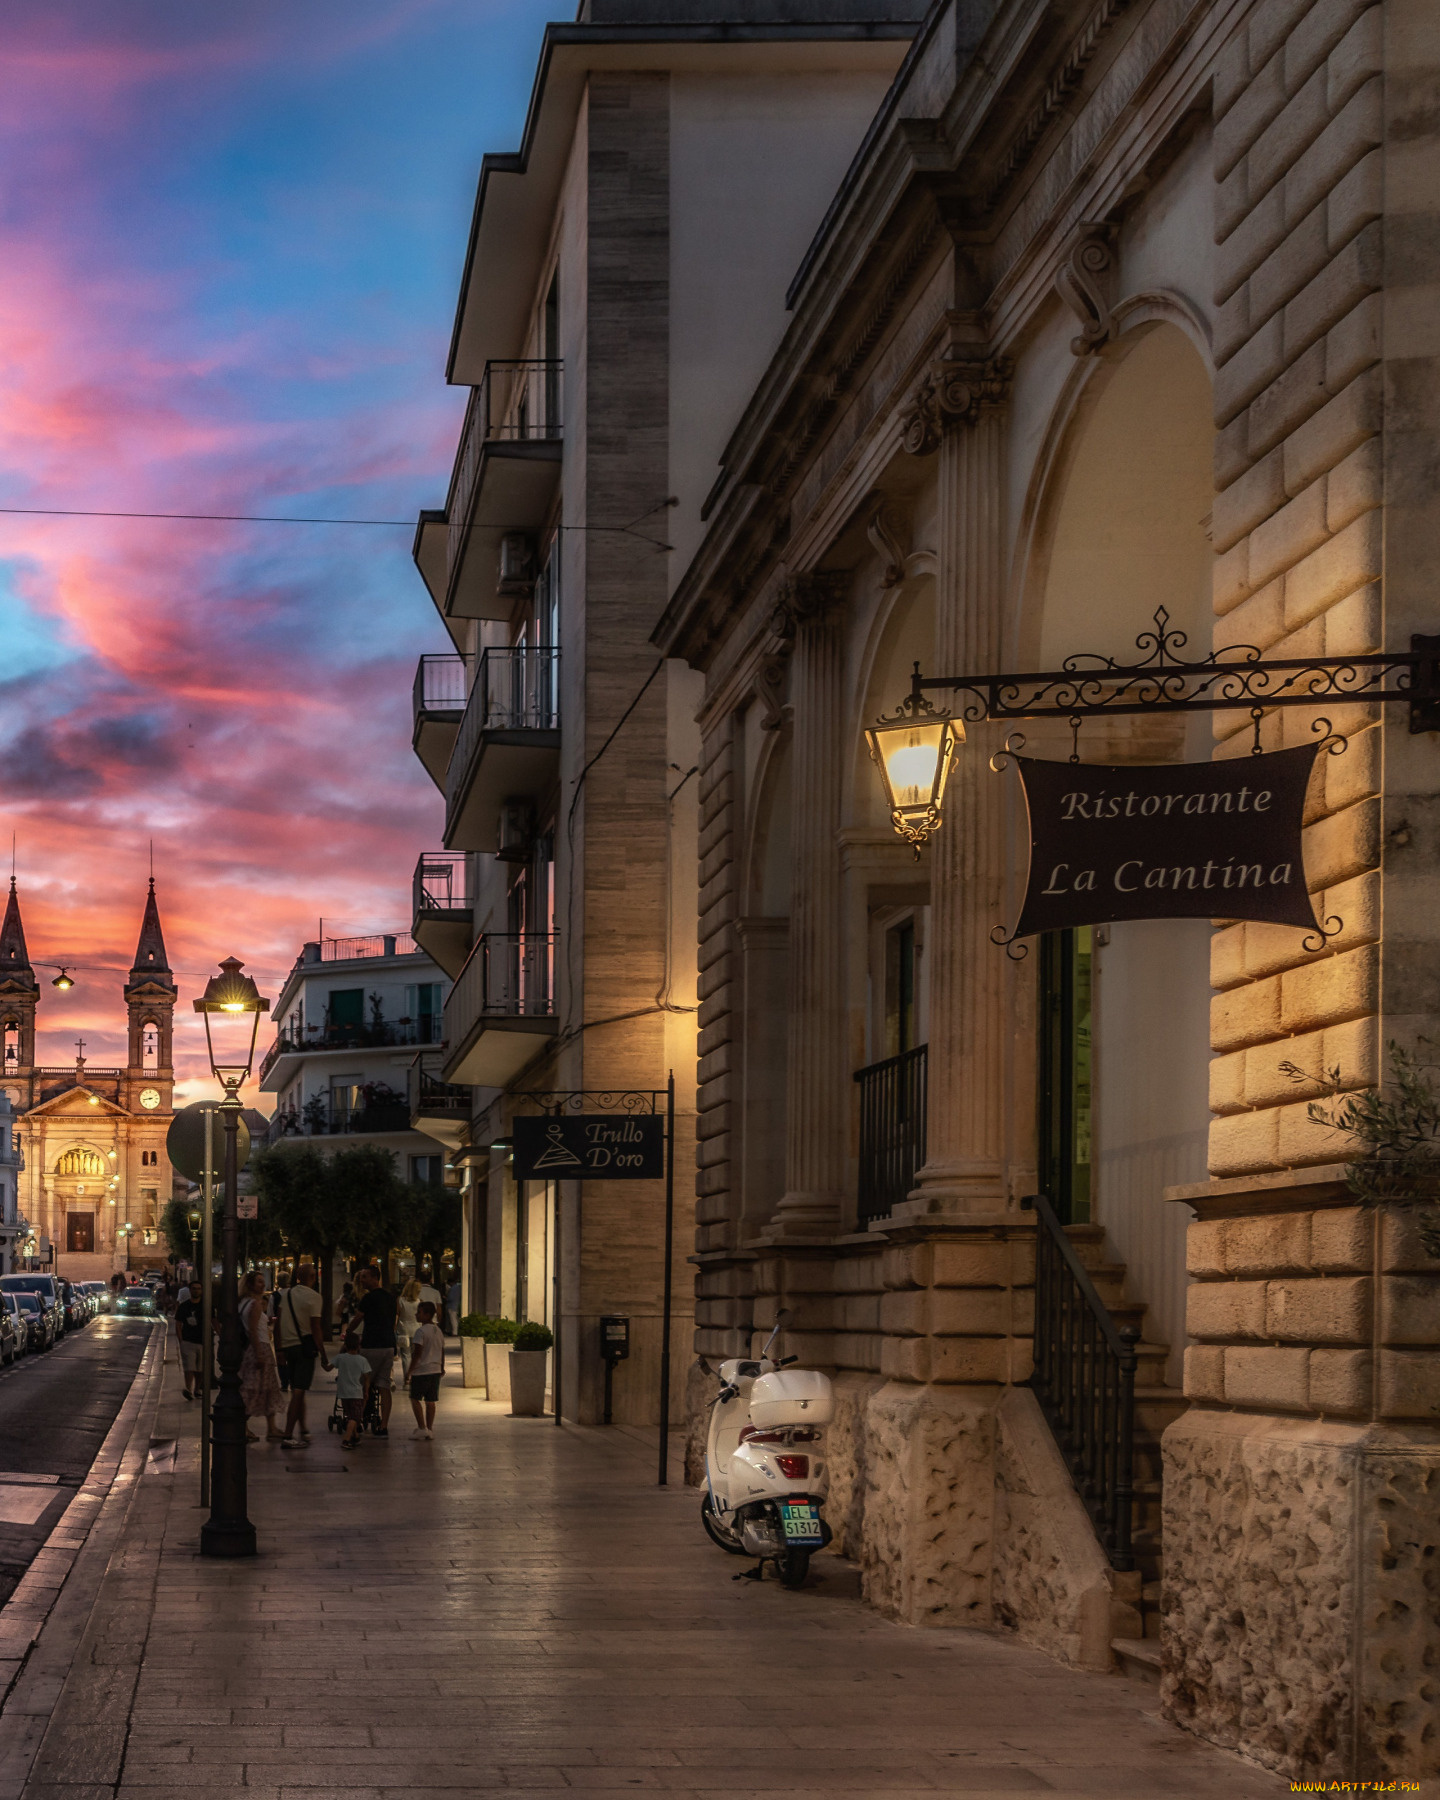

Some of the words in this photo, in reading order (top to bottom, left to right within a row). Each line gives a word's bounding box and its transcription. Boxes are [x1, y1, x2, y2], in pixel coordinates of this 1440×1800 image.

[1060, 786, 1272, 820] Ristorante
[1040, 863, 1097, 895] La
[1113, 856, 1292, 893] Cantina
[585, 1121, 644, 1143] Trullo
[586, 1147, 644, 1168] D'oro
[791, 1506, 806, 1519] EL
[786, 1521, 820, 1534] 51312
